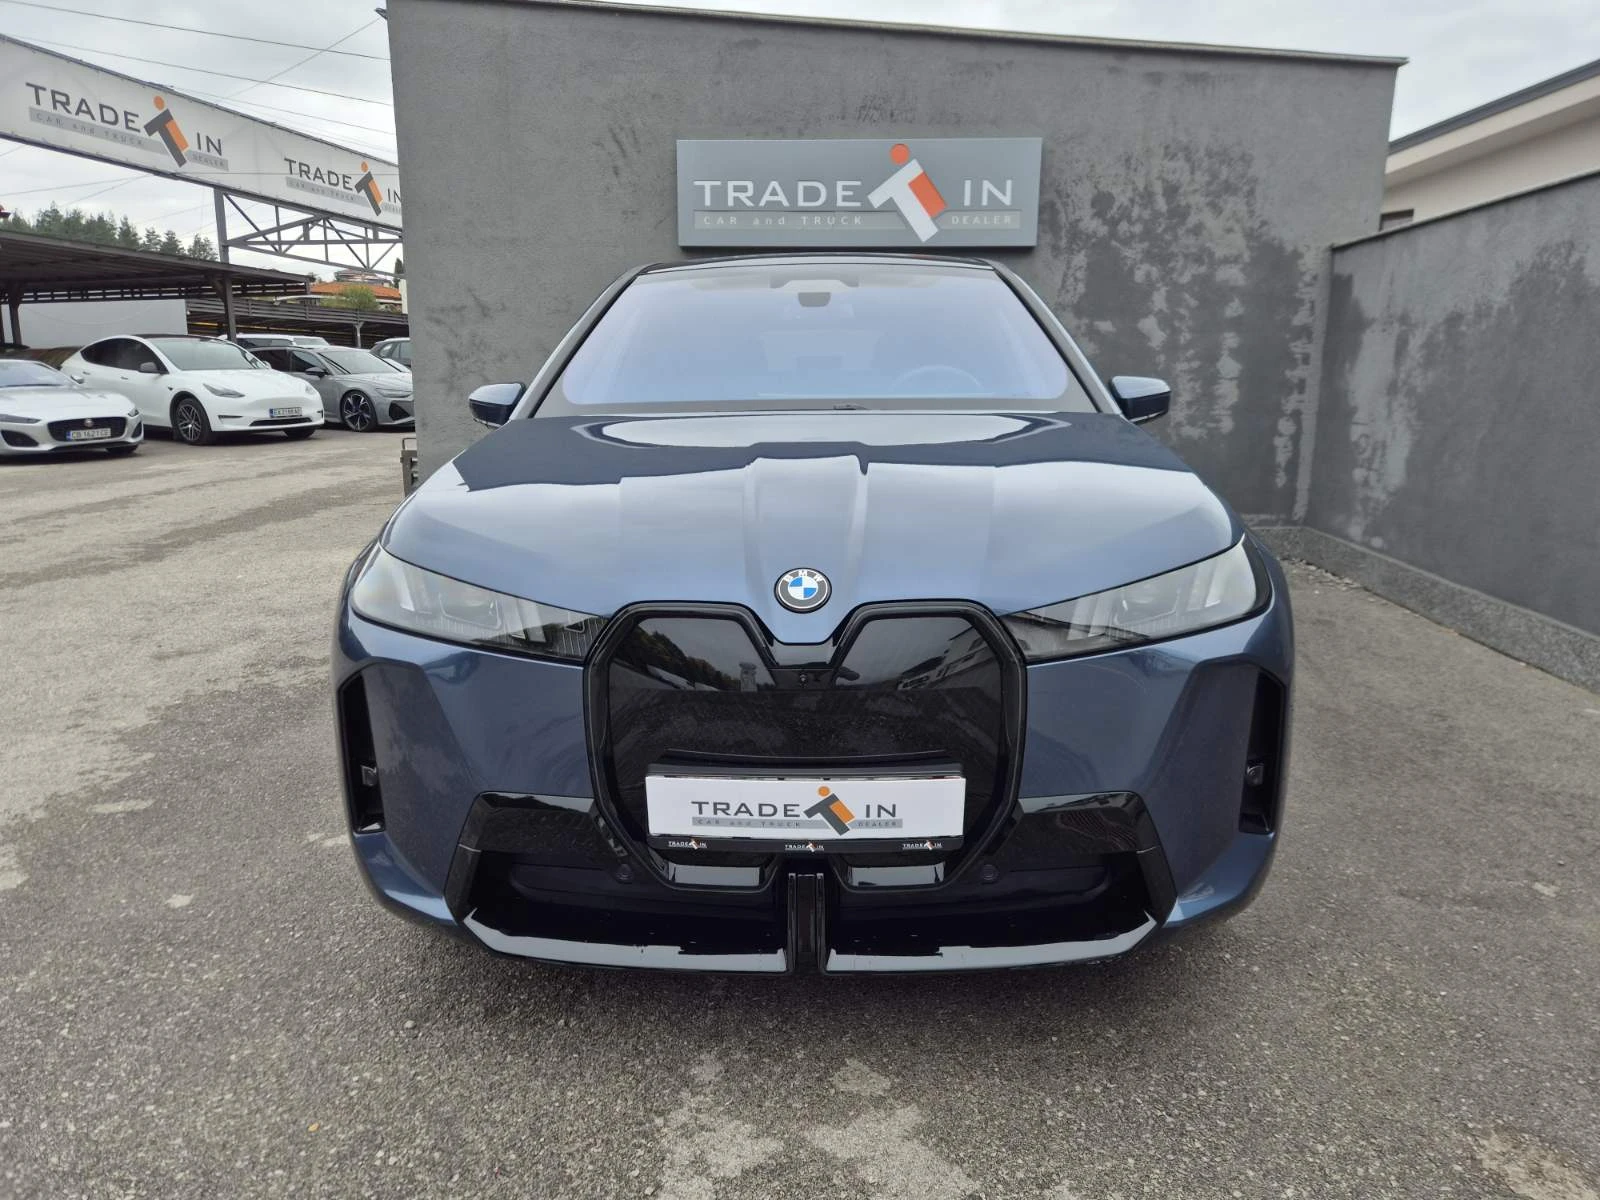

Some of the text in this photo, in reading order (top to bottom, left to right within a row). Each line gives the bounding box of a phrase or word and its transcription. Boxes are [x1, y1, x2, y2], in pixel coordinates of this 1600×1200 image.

[25, 82, 141, 133] TRADE
[196, 131, 222, 156] IN
[284, 157, 353, 191] TRADE
[693, 180, 862, 207] TRADE
[963, 179, 1012, 206] IN
[703, 215, 1012, 225] CAR and TRUCK DEALER
[783, 569, 825, 582] BMW
[691, 801, 800, 817] TRADE
[866, 804, 896, 818] IN
[761, 820, 800, 828] TRUCK
